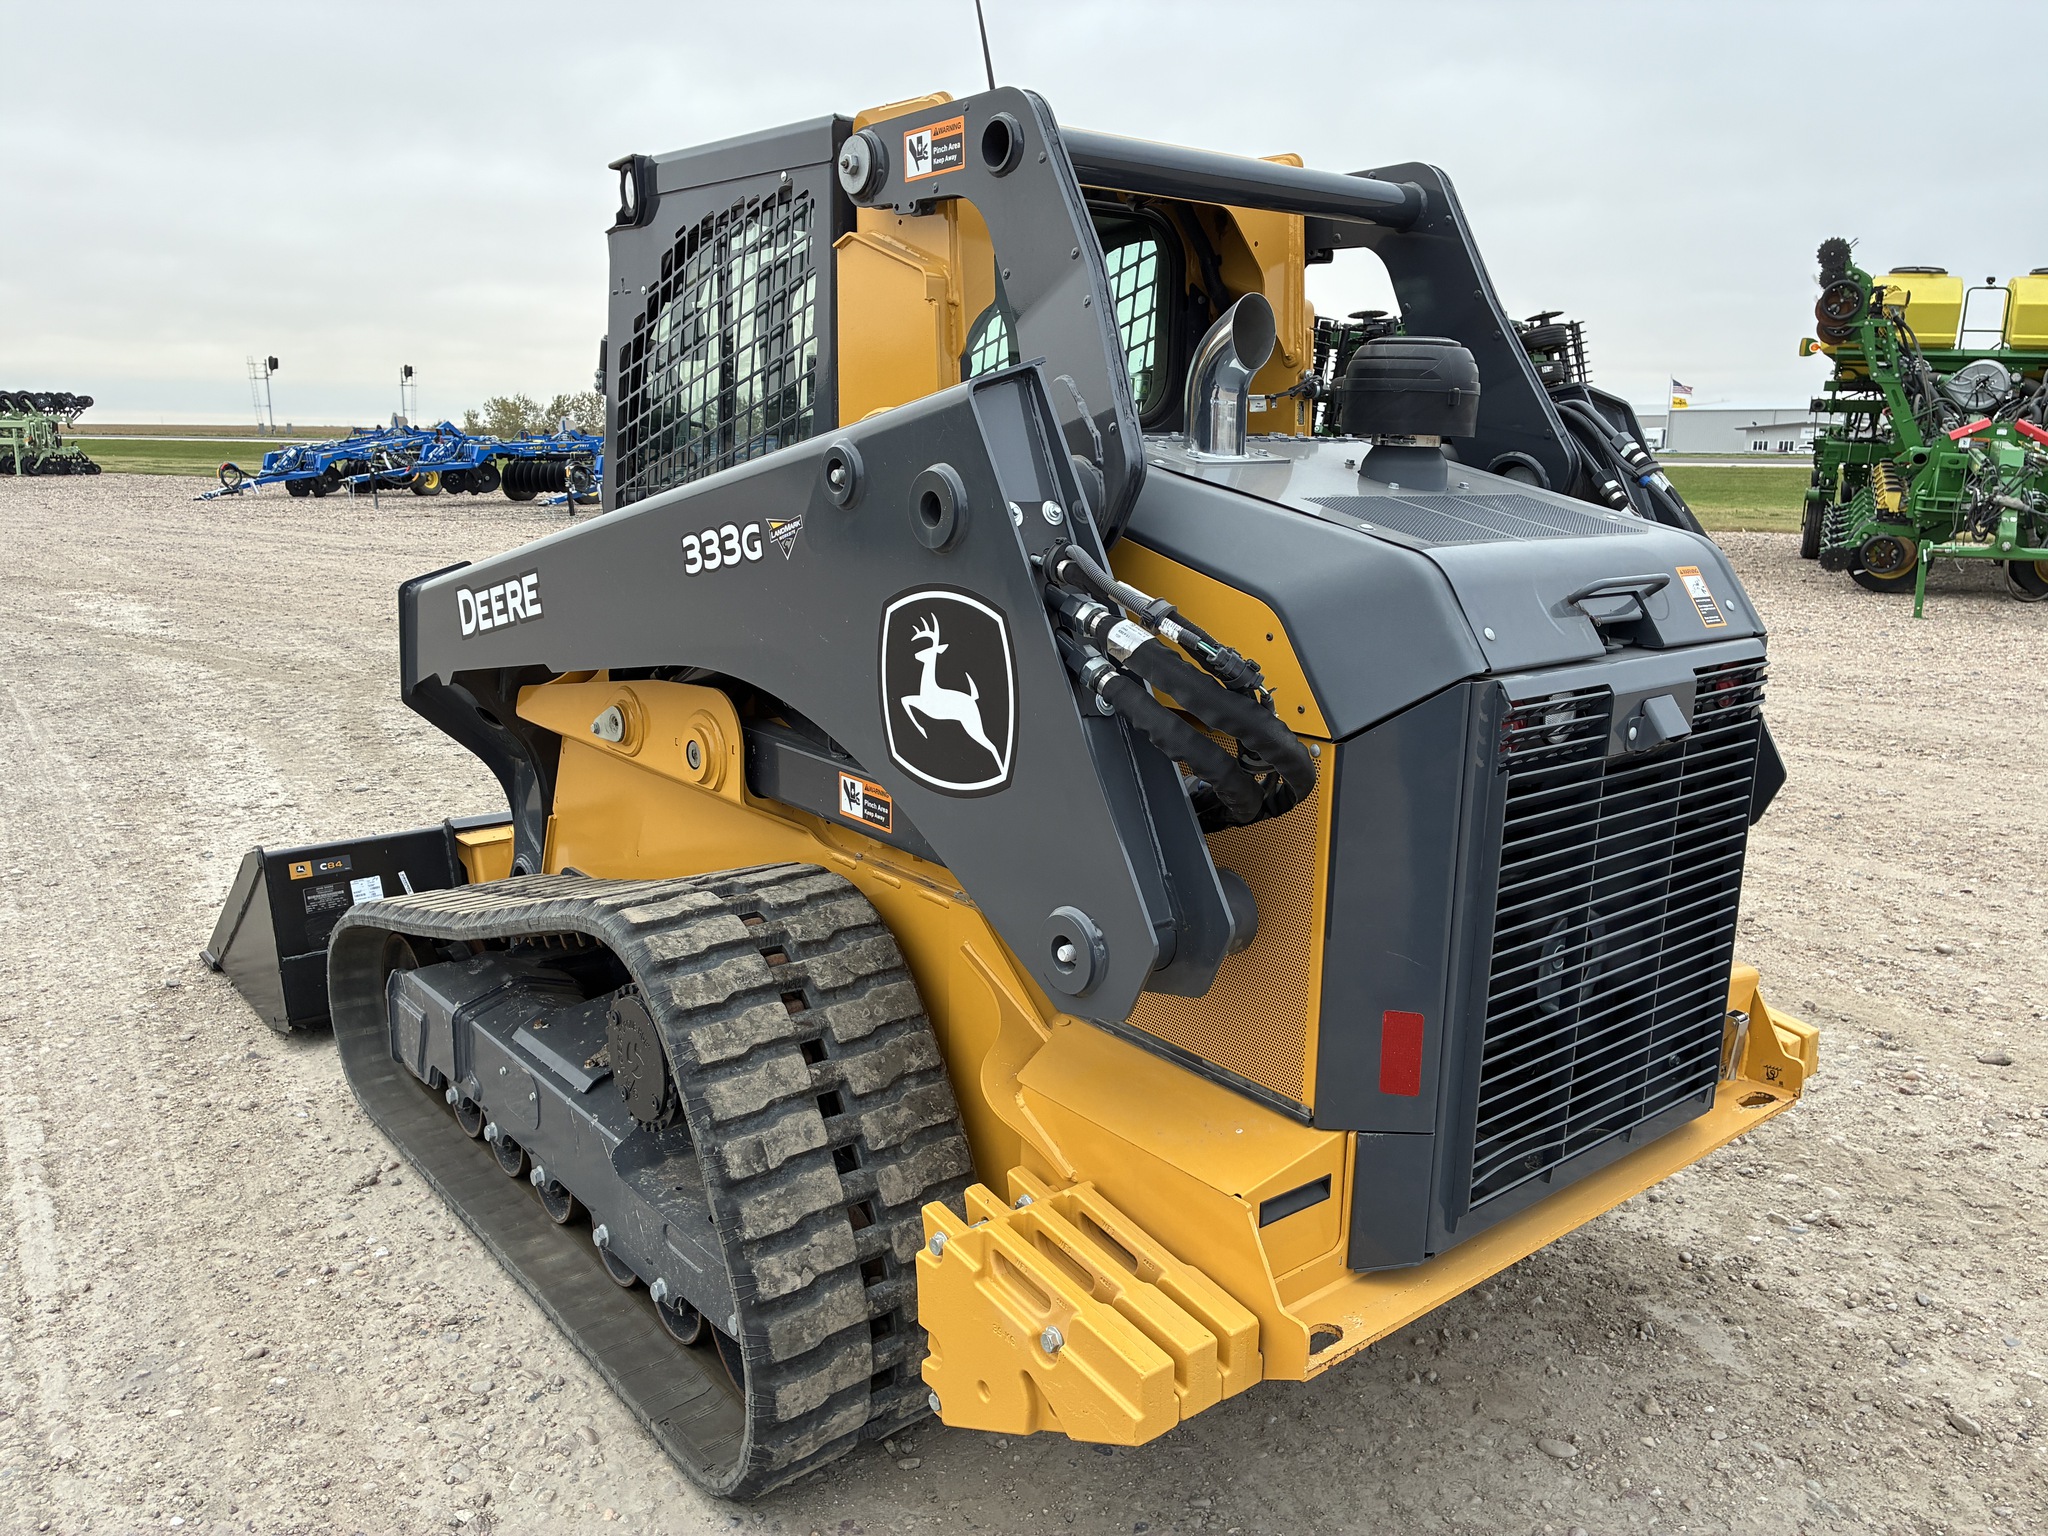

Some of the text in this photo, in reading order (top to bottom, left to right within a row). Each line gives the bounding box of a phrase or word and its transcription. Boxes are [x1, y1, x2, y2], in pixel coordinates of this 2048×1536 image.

[938, 122, 962, 133] WARNING
[933, 141, 961, 155] Pinch Area
[933, 153, 957, 165] Keep Away
[682, 523, 763, 574] 333G
[456, 572, 542, 636] DEERE
[864, 799, 889, 814] Pinch Area
[864, 808, 886, 823] Keep Away
[319, 860, 343, 871] C84
